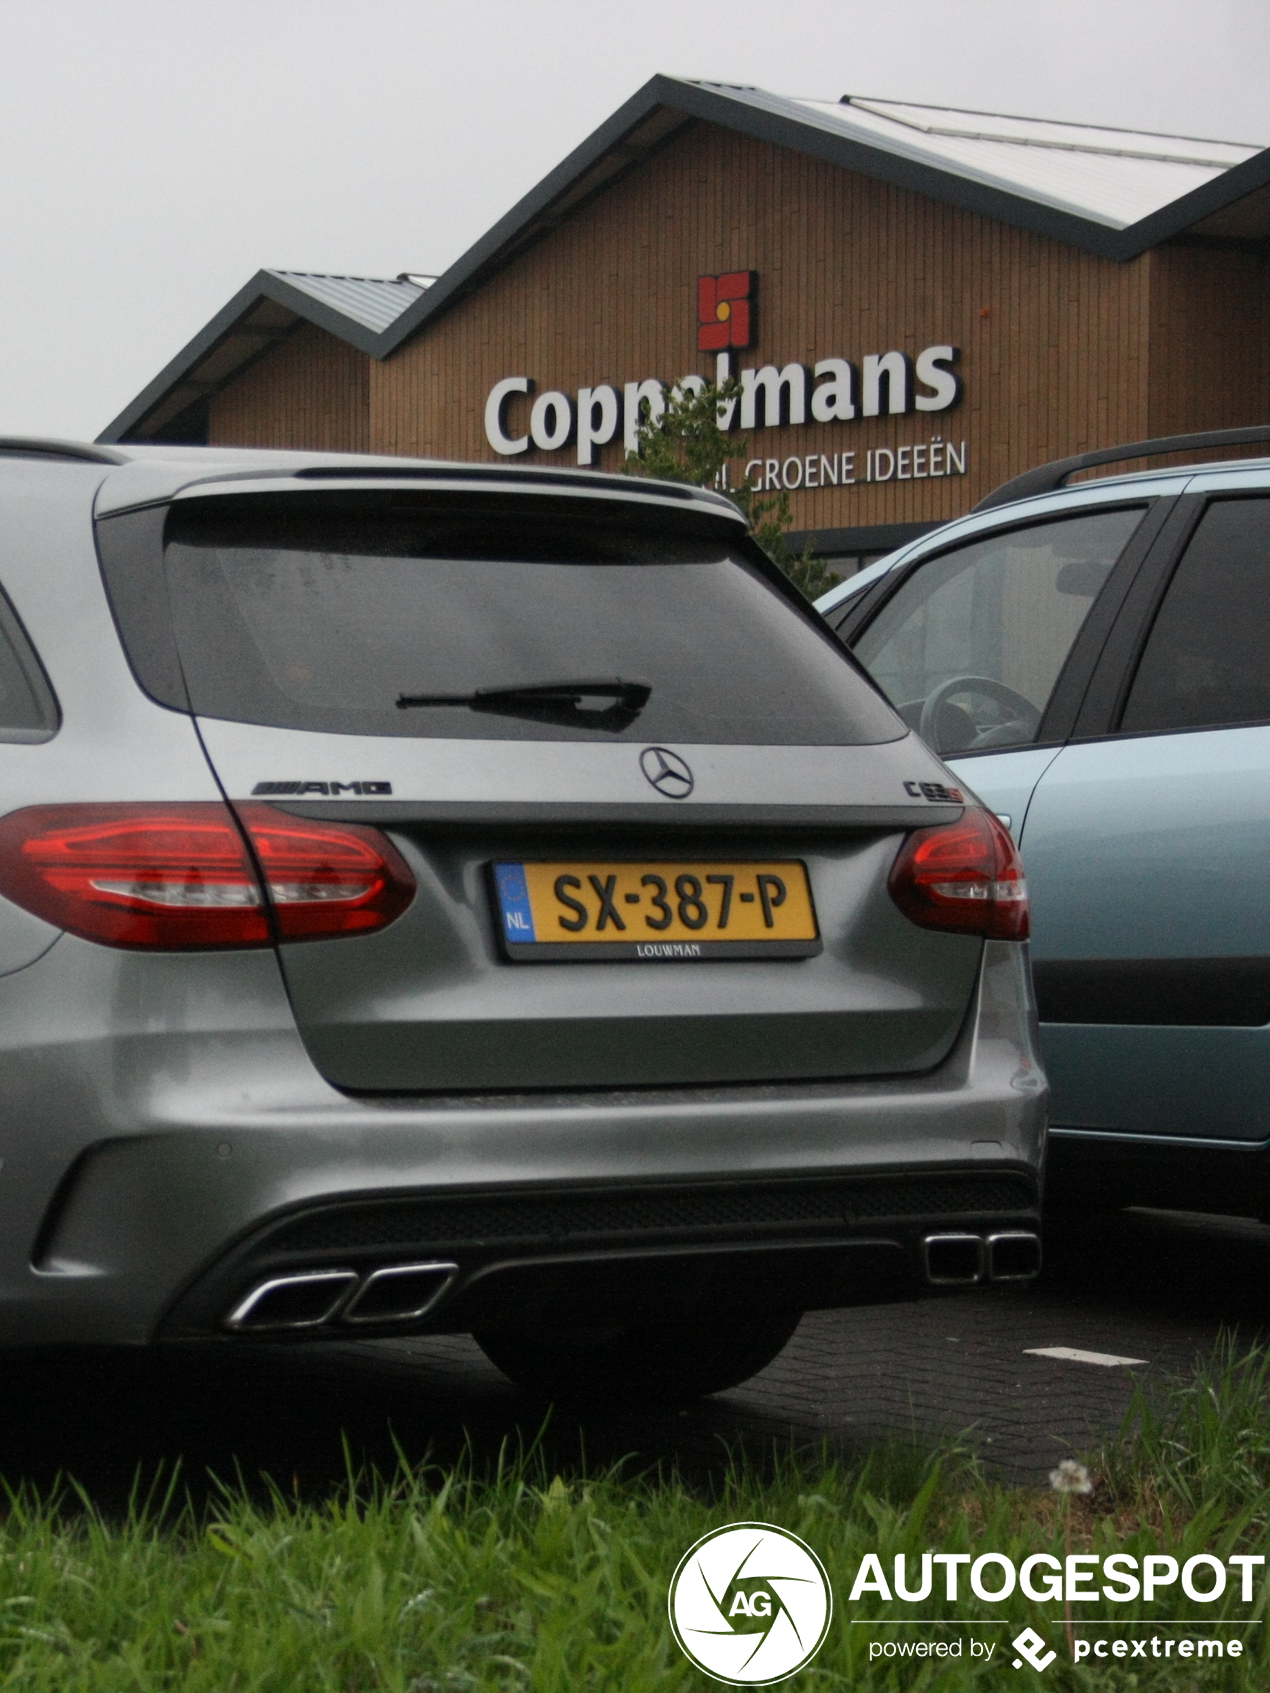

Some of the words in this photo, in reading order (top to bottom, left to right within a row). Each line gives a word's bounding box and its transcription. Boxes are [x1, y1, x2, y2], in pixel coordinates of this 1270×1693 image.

[744, 453, 856, 492] GROENE
[866, 437, 966, 482] IDEEËN
[295, 781, 393, 795] AMG
[553, 874, 787, 931] SX-387-P
[506, 912, 529, 930] NL
[636, 944, 701, 957] LOUWMAN
